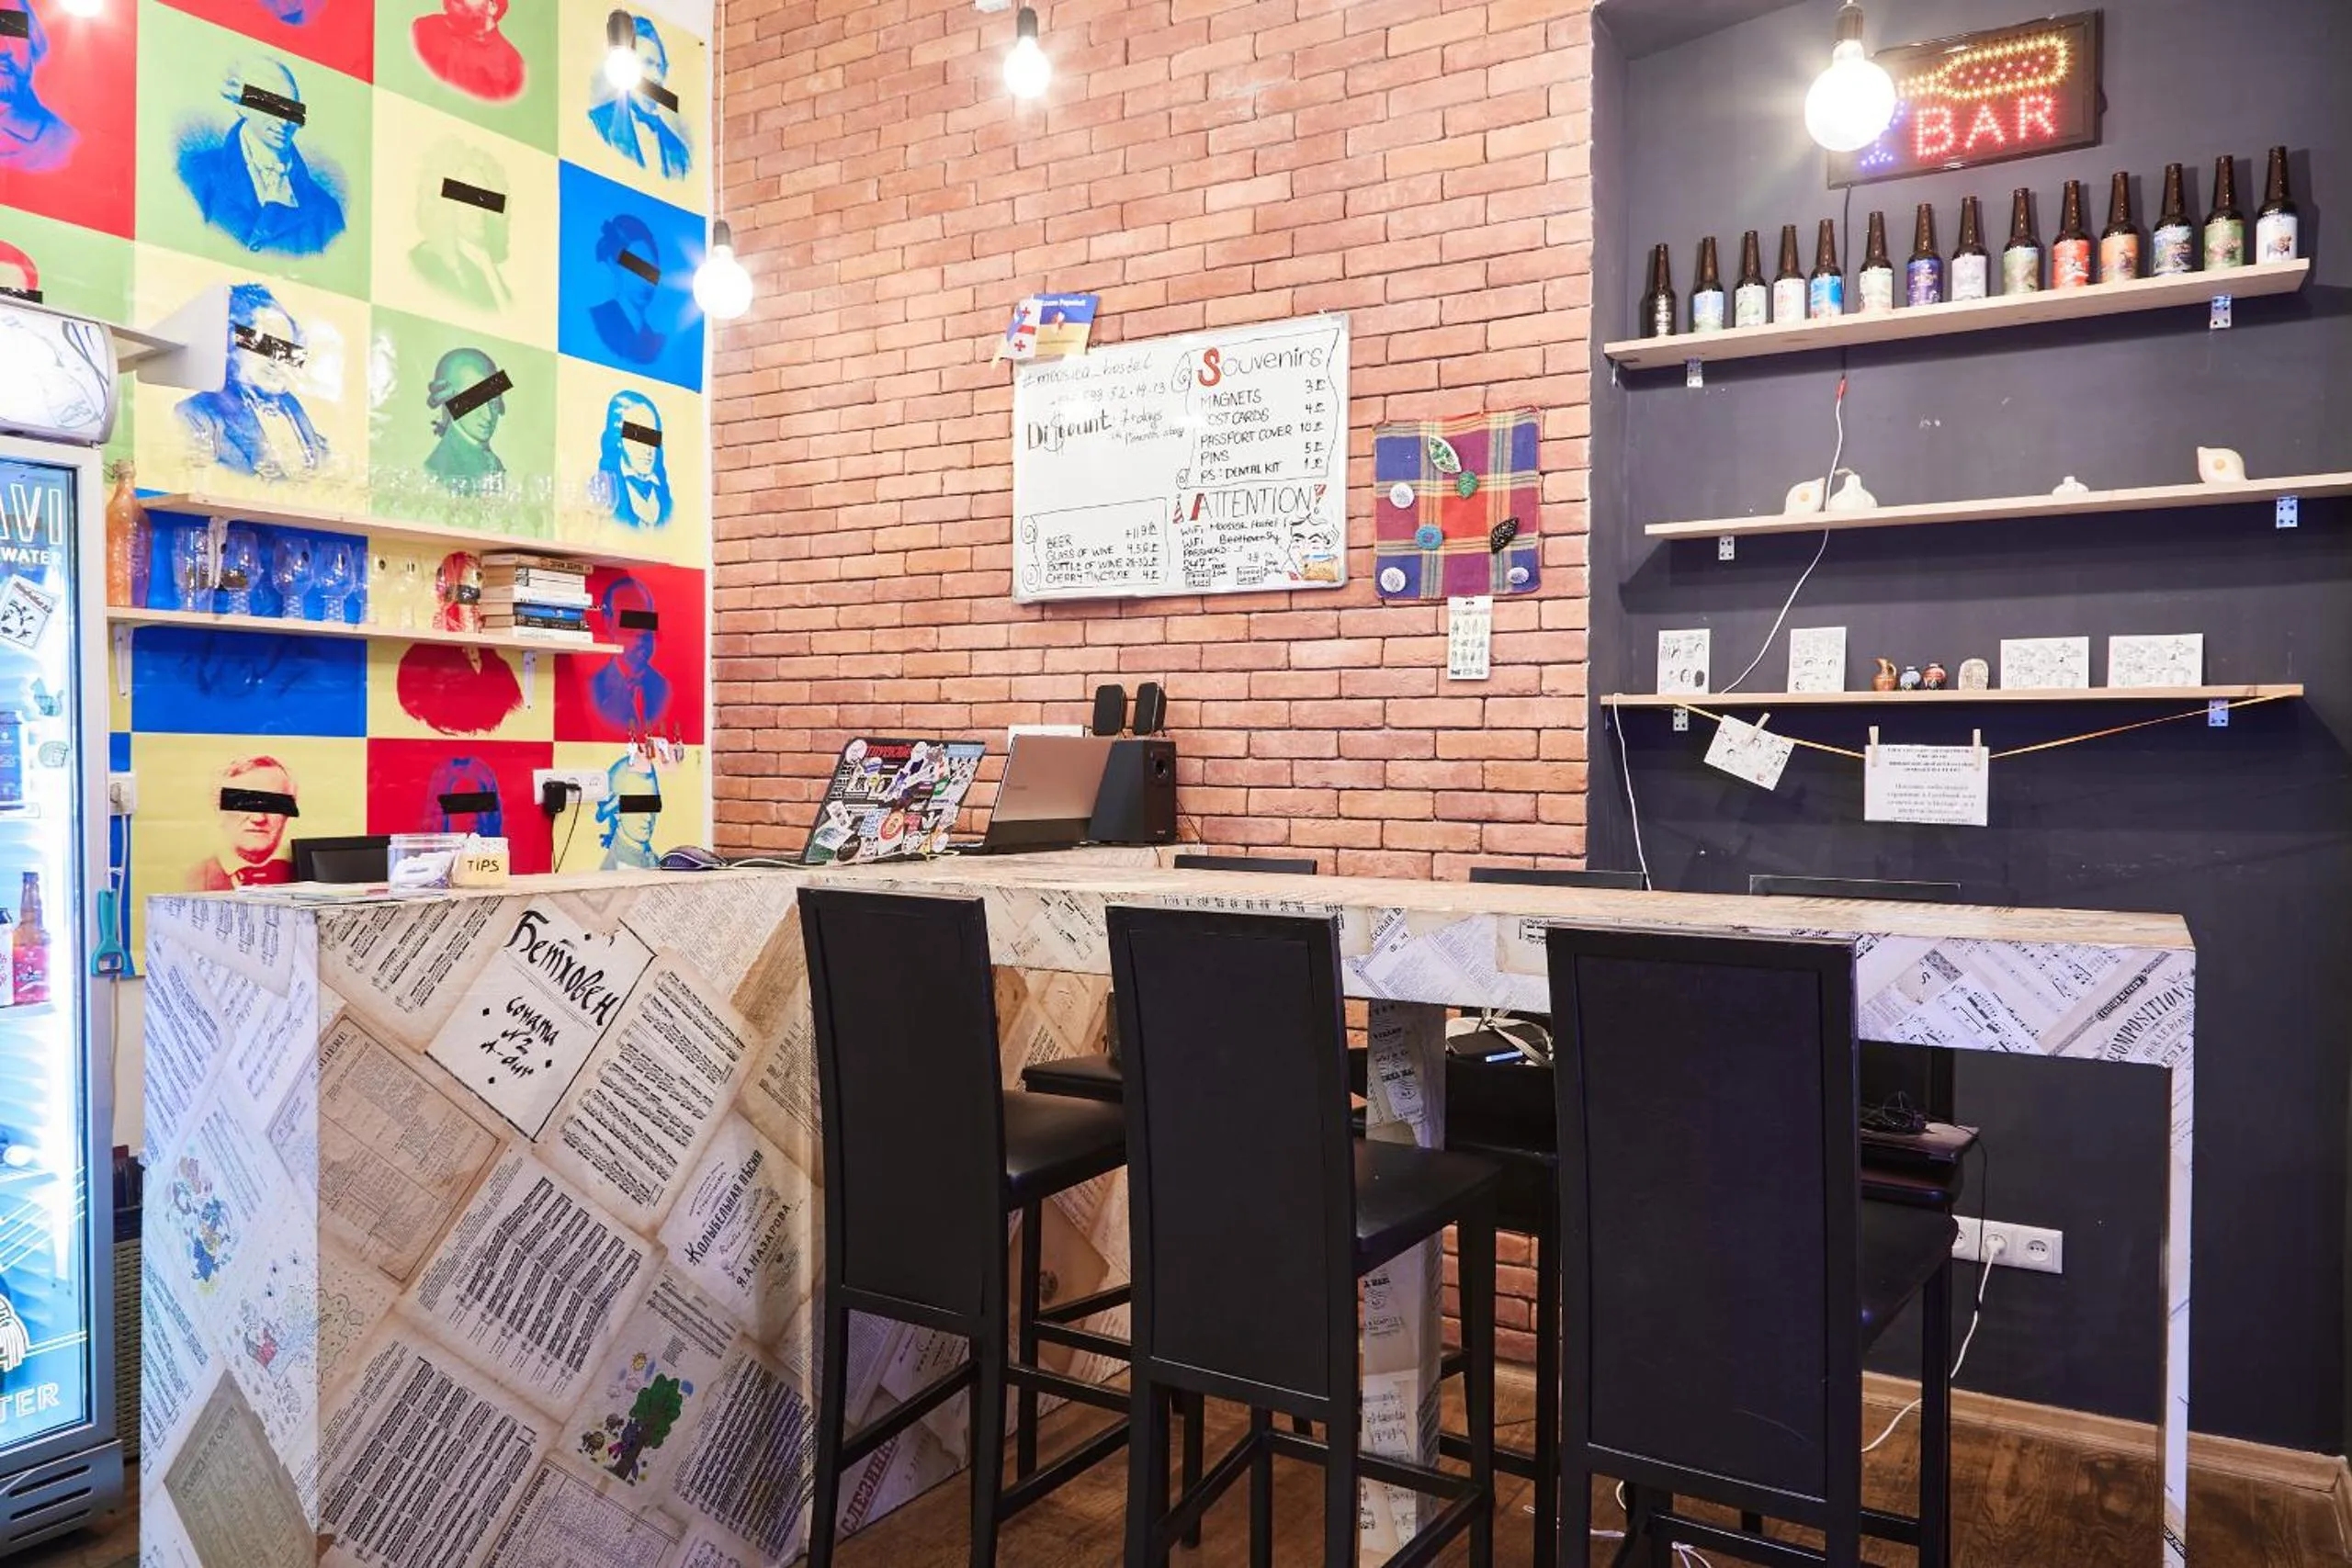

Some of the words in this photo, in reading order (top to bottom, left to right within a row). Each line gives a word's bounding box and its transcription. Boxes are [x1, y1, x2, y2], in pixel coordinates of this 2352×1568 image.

[1915, 94, 2057, 158] BAR
[1195, 347, 1323, 387] Souvenirs
[1201, 389, 1261, 410] MAGNETS
[1201, 432, 1255, 449] PASSPORT
[1259, 424, 1293, 442] COVER
[1201, 449, 1230, 467] PINS
[1226, 464, 1261, 479] DENTAL
[1265, 461, 1283, 474] KIT
[1046, 534, 1072, 549] BEER
[1, 547, 63, 566] WATER
[1046, 549, 1075, 562] GLASS
[1046, 561, 1081, 572] BOTTLE
[467, 860, 500, 873] TIPS
[504, 909, 620, 1026] Бетховен
